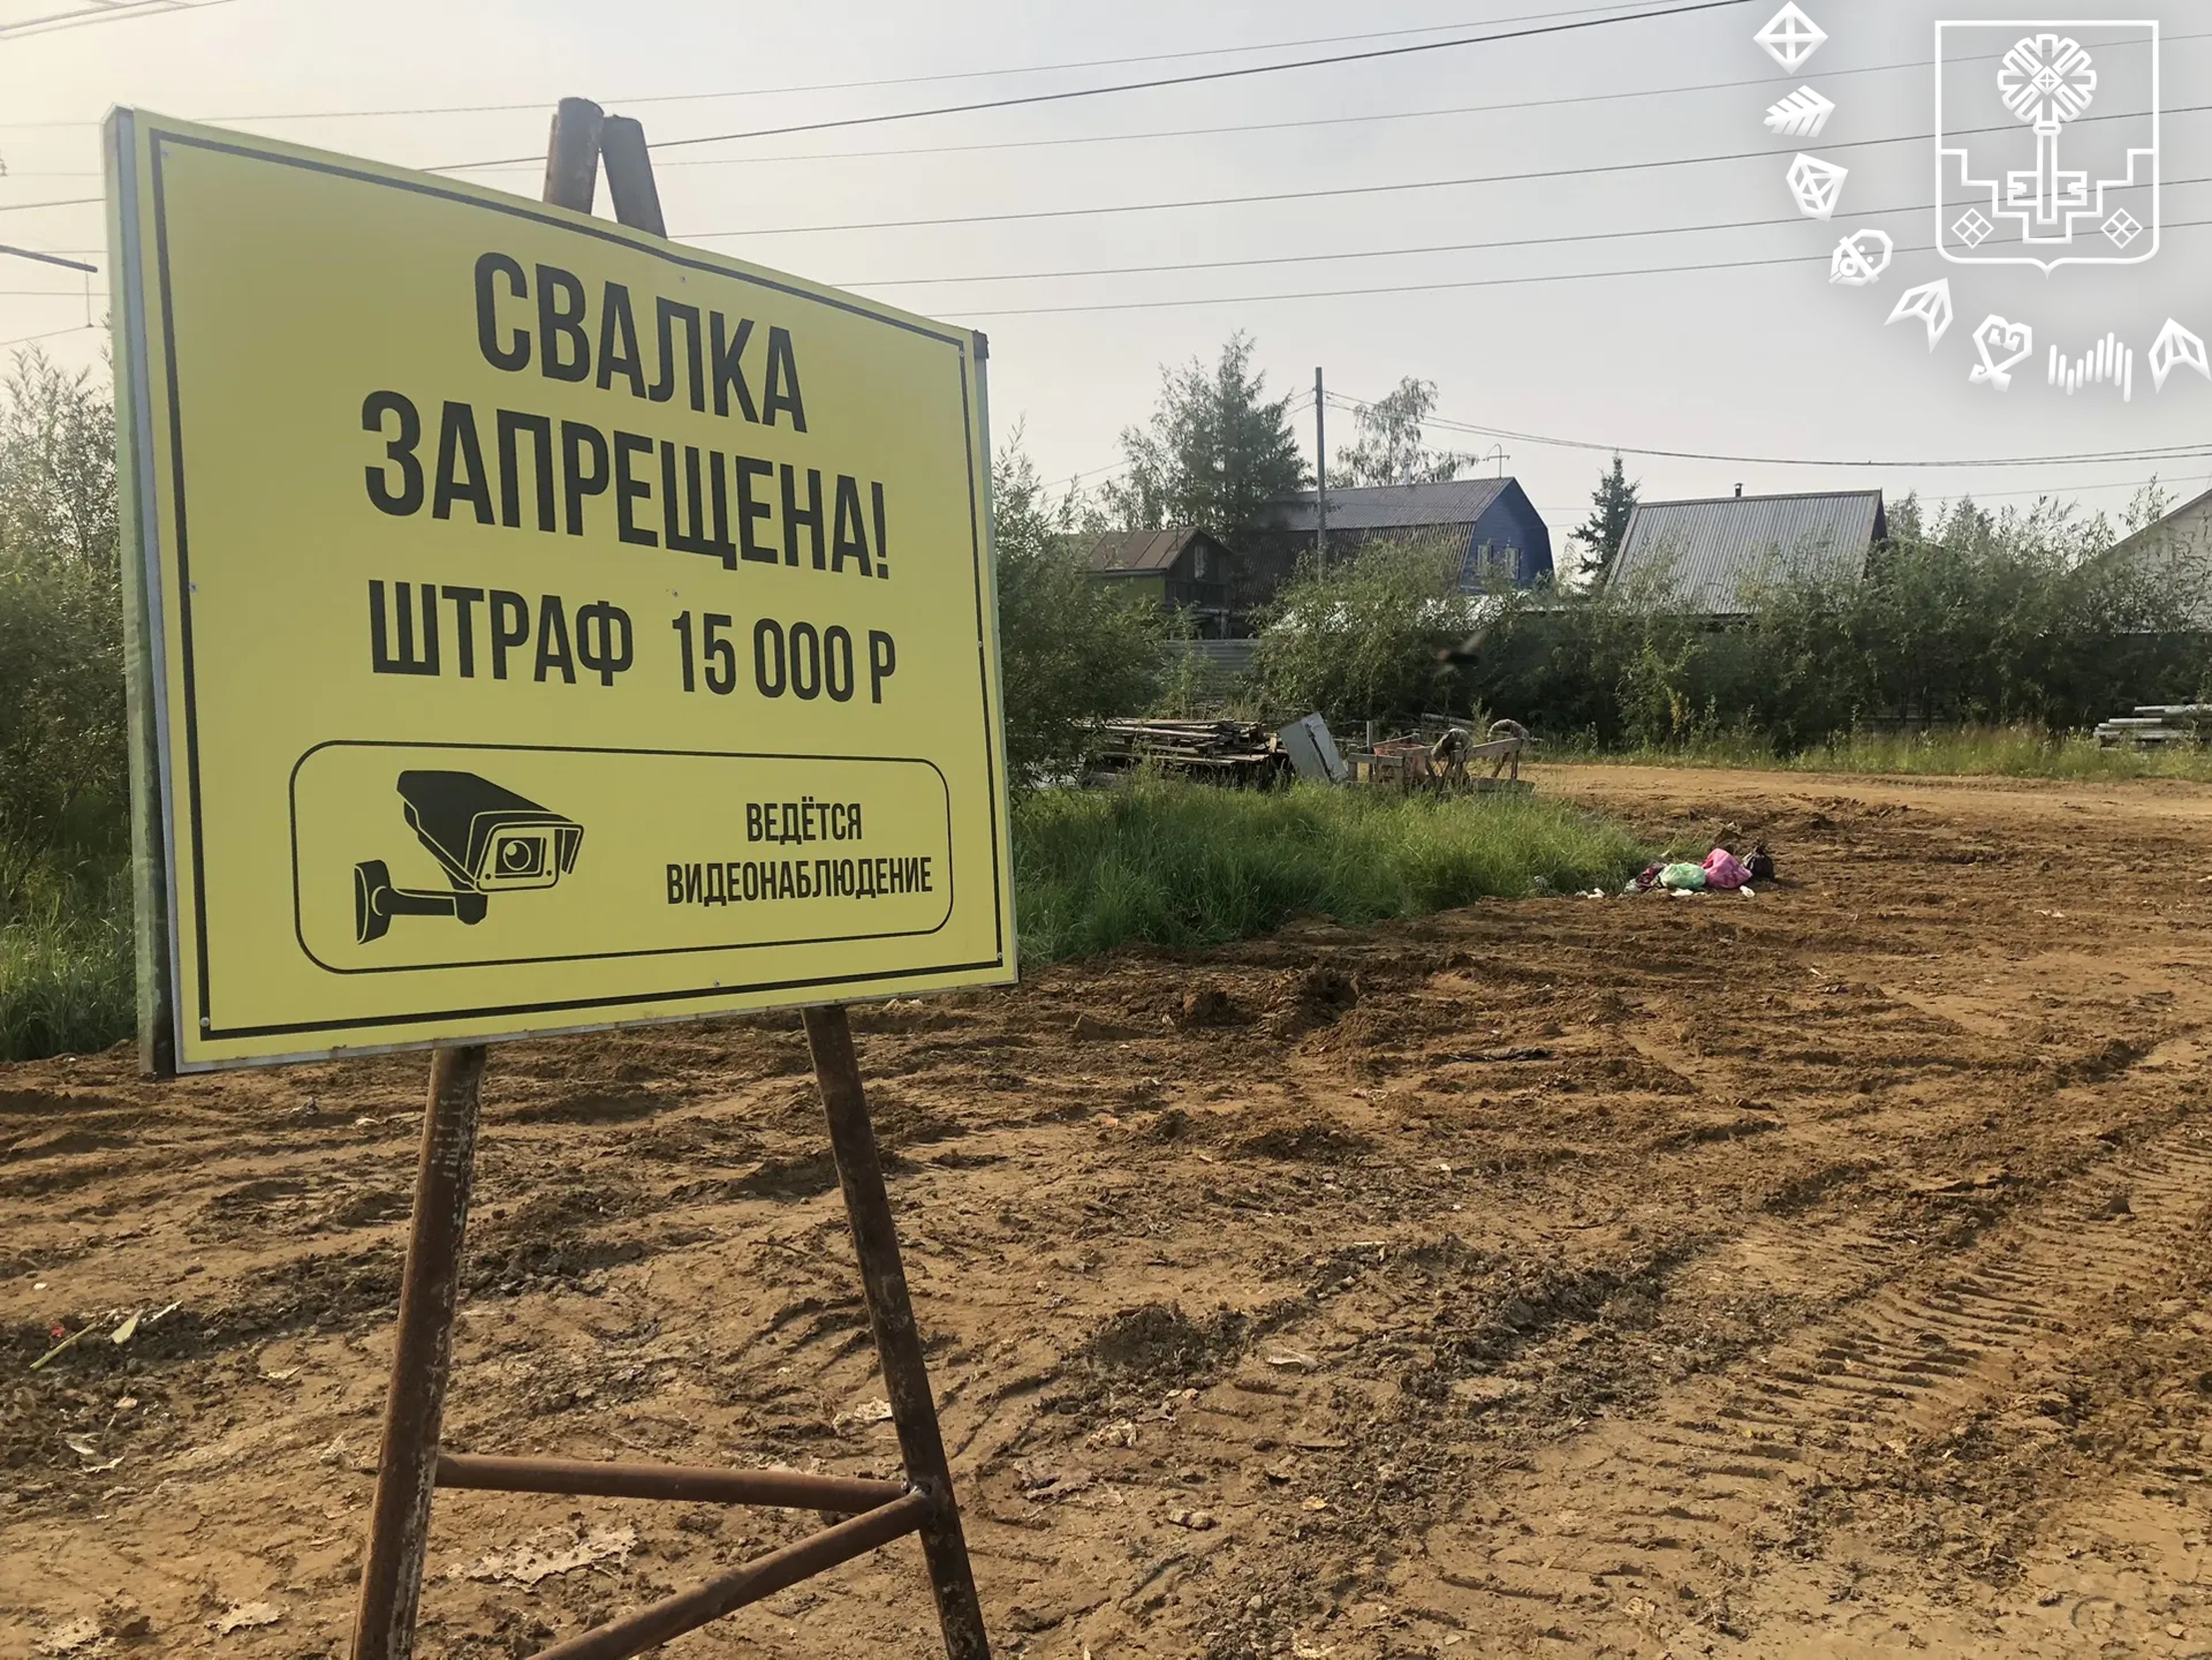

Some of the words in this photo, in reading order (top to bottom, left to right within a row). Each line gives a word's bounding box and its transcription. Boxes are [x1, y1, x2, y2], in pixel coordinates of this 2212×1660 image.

[474, 252, 808, 434] СВАЛКА
[362, 390, 889, 580] ЗАПРЕЩЕНА!
[368, 579, 633, 687] ШТРАФ
[671, 610, 736, 696] 15
[753, 618, 854, 703] 000
[868, 629, 896, 704] Р
[666, 857, 933, 907] ВИДЕОНАБЛЮДЕНИЕ
[746, 796, 862, 845] ВЕДЁТСЯ
